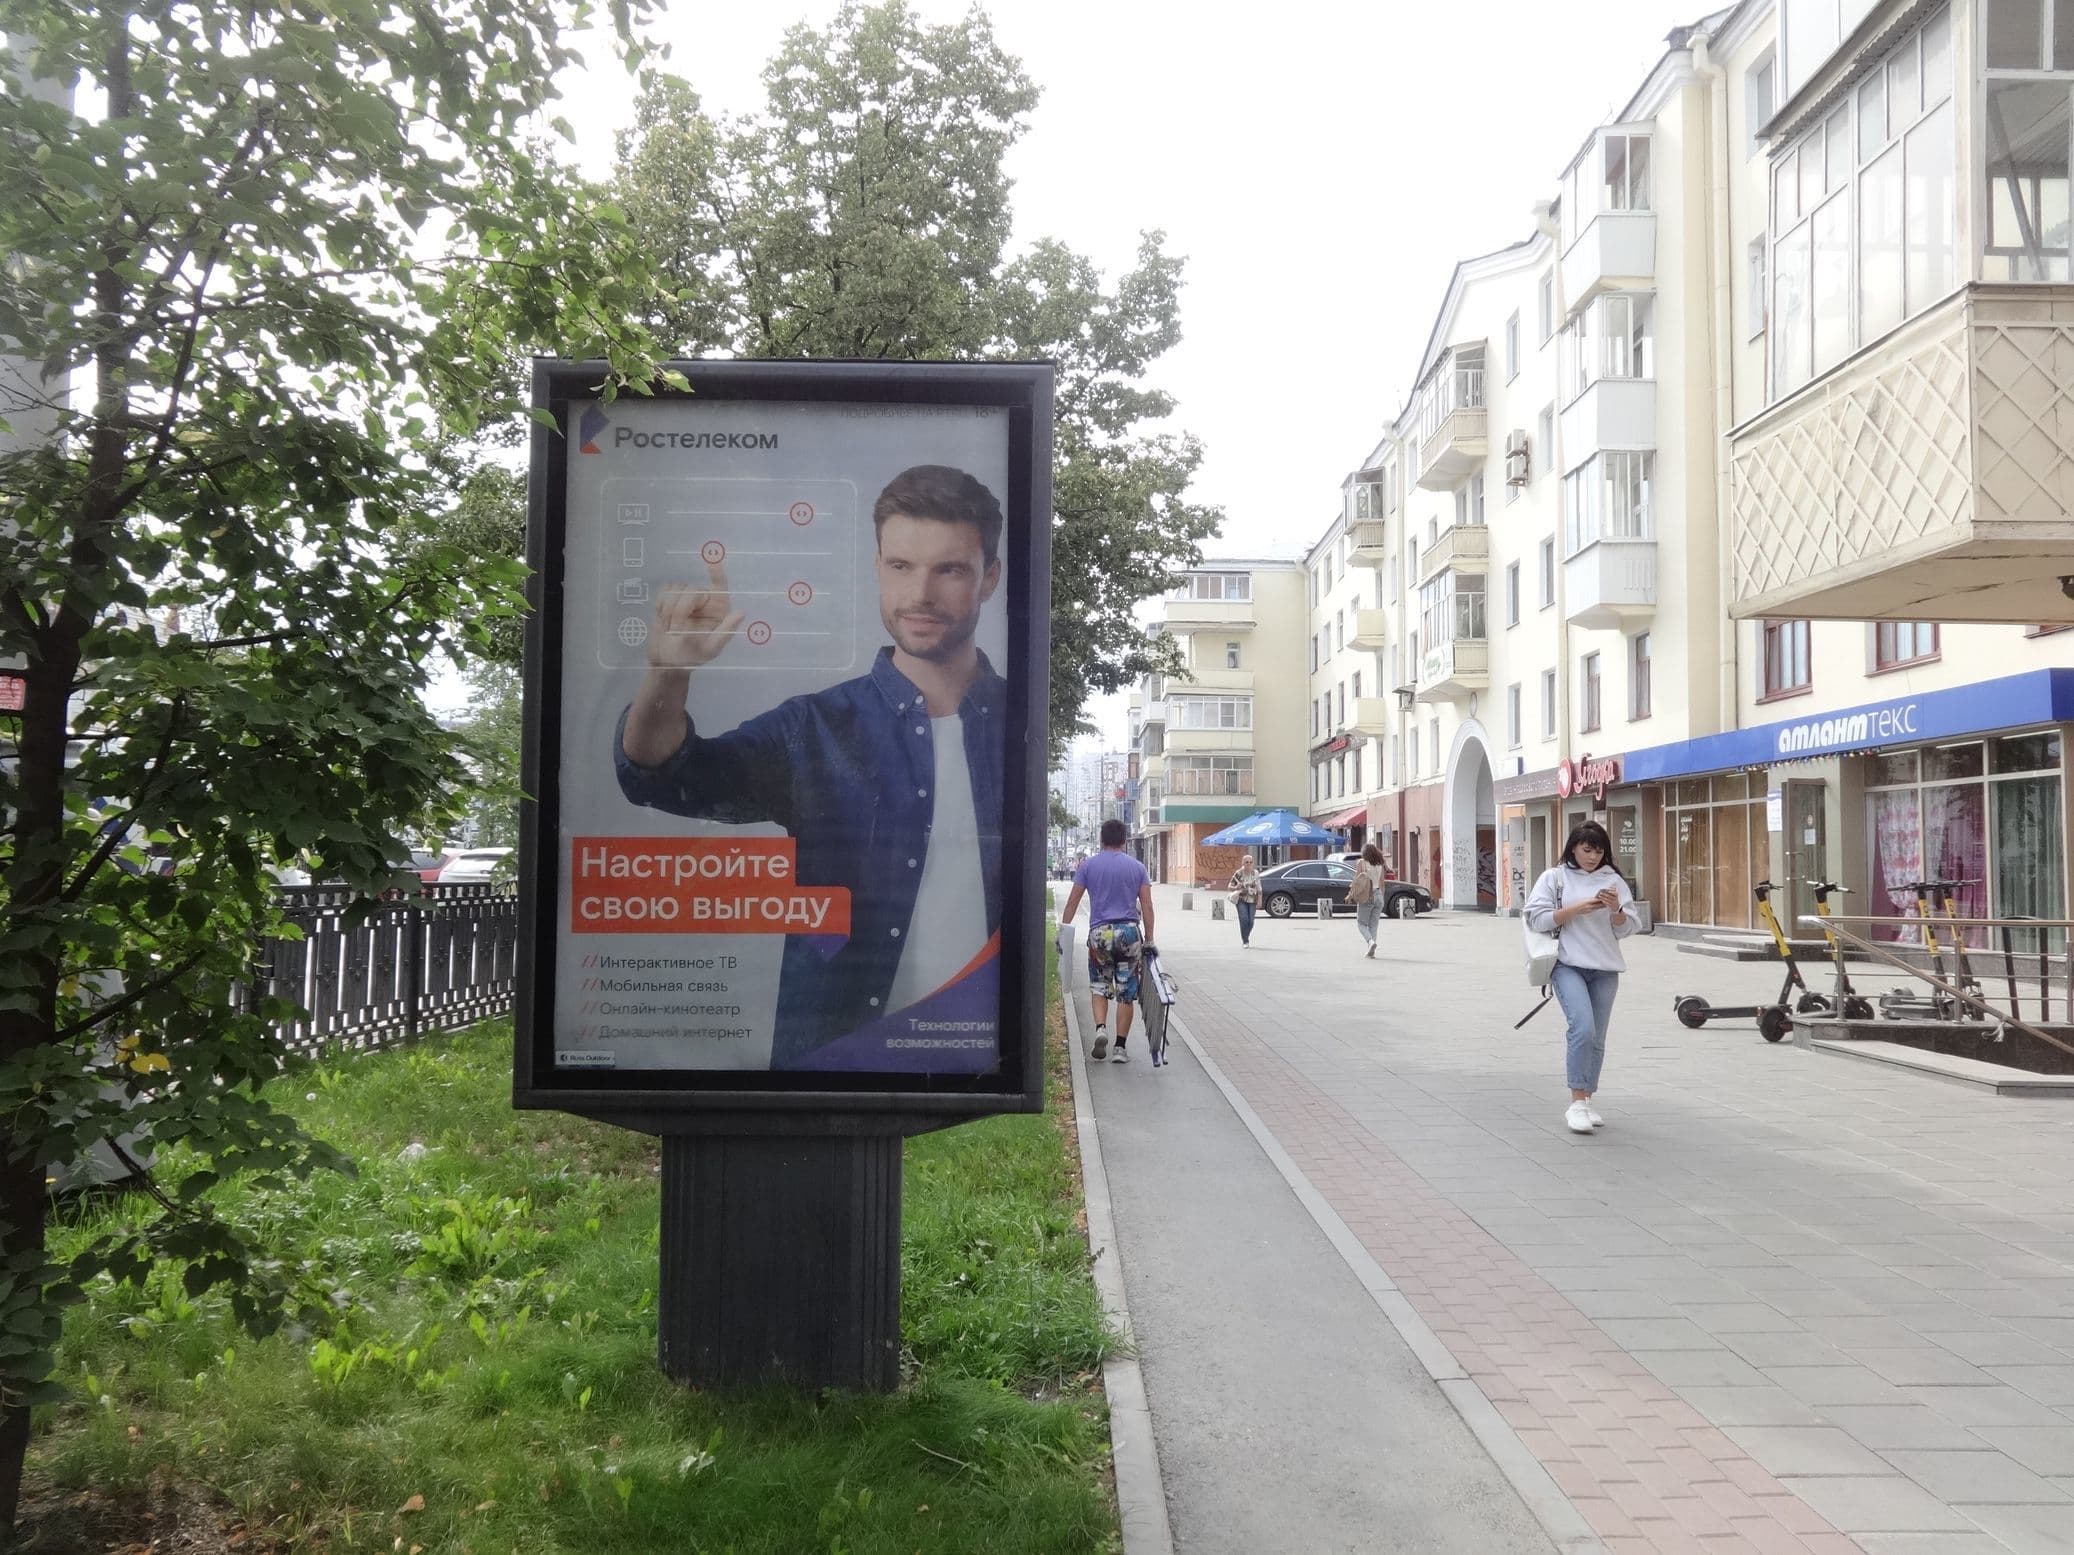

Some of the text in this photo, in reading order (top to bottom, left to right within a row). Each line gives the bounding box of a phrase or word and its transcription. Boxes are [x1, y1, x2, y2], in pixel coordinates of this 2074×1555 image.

[615, 427, 778, 449] Ростелеком
[582, 847, 789, 886] Настройте
[580, 896, 831, 928] свою выгоду
[600, 956, 737, 971] Интерактивное ТВ
[600, 979, 728, 992] Мобильная связь
[600, 1002, 740, 1017] Онлайн-кинотеатр
[909, 1019, 995, 1031] Технологии
[683, 1027, 752, 1041] интернет
[886, 1037, 995, 1049] возможностей
